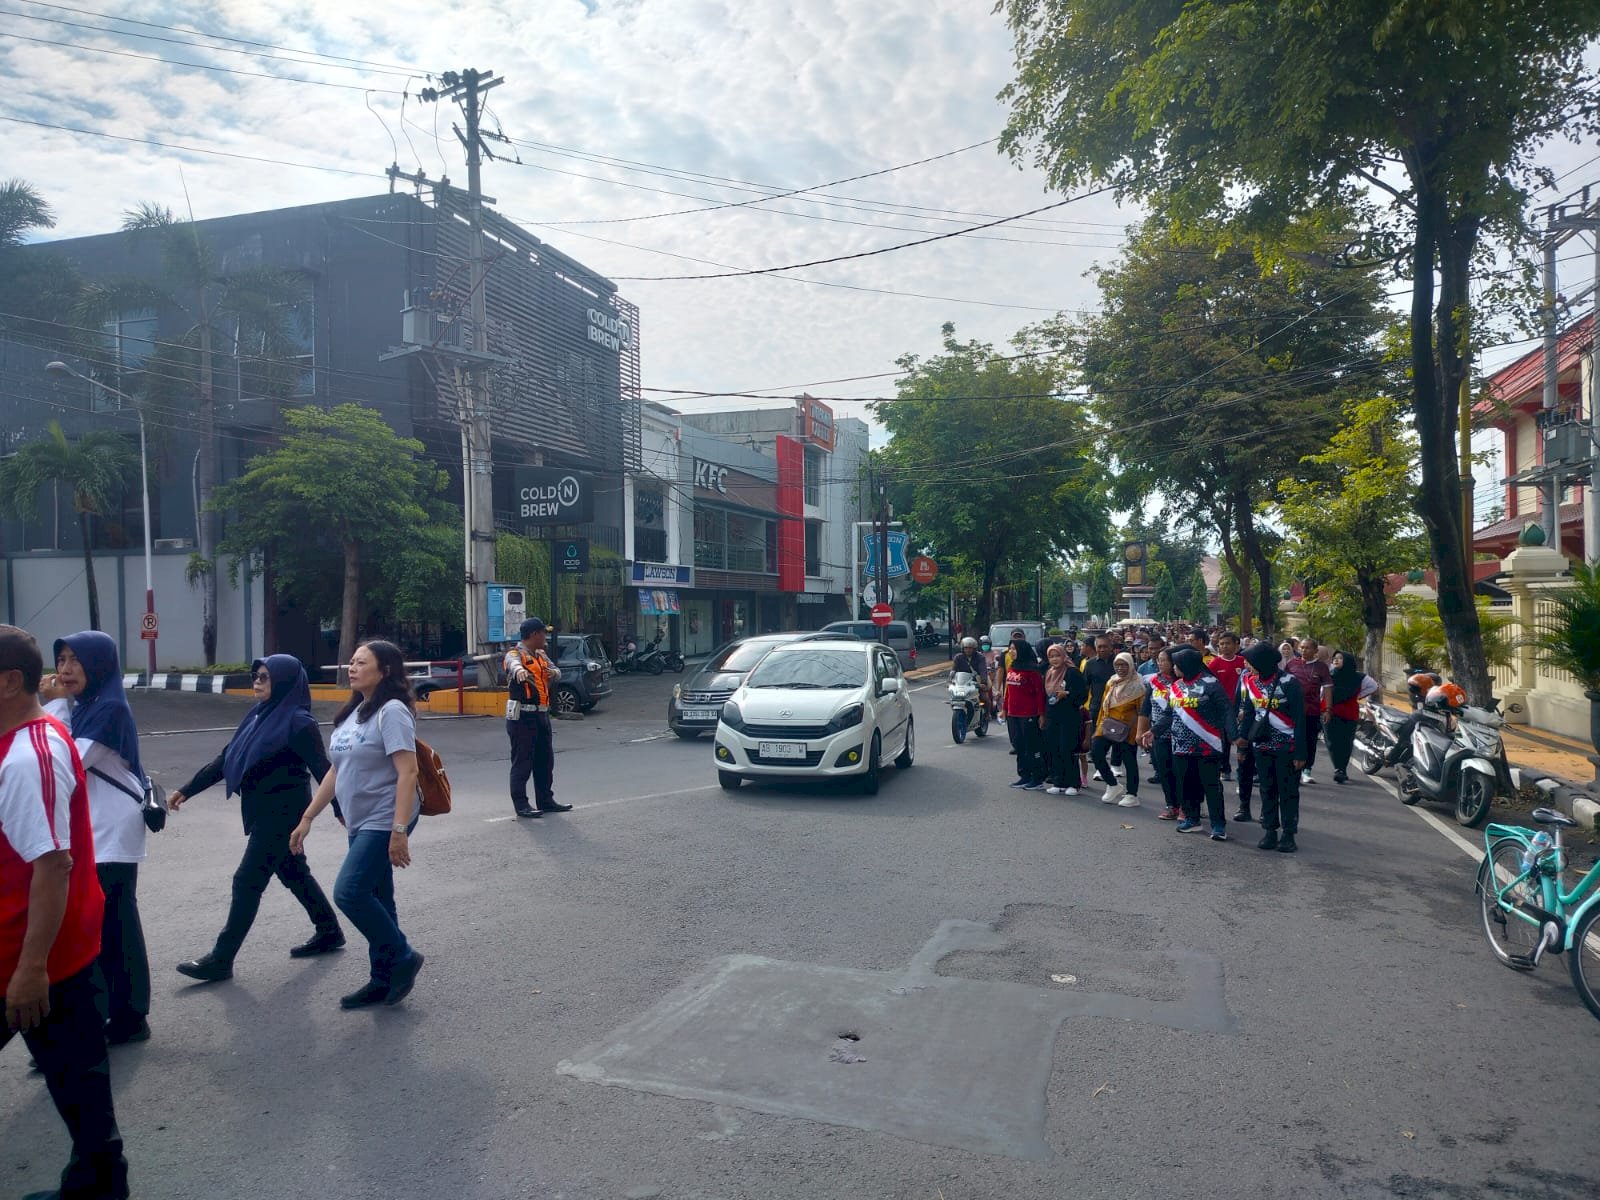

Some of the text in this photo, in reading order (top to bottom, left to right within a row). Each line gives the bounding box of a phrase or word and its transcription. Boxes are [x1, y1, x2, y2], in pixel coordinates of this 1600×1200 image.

[587, 309, 618, 333] COLD
[588, 325, 620, 352] BREW
[694, 460, 728, 494] KFC
[520, 486, 557, 501] COLD
[520, 502, 559, 517] BREW
[645, 566, 677, 580] LAWSON
[761, 743, 770, 753] AB
